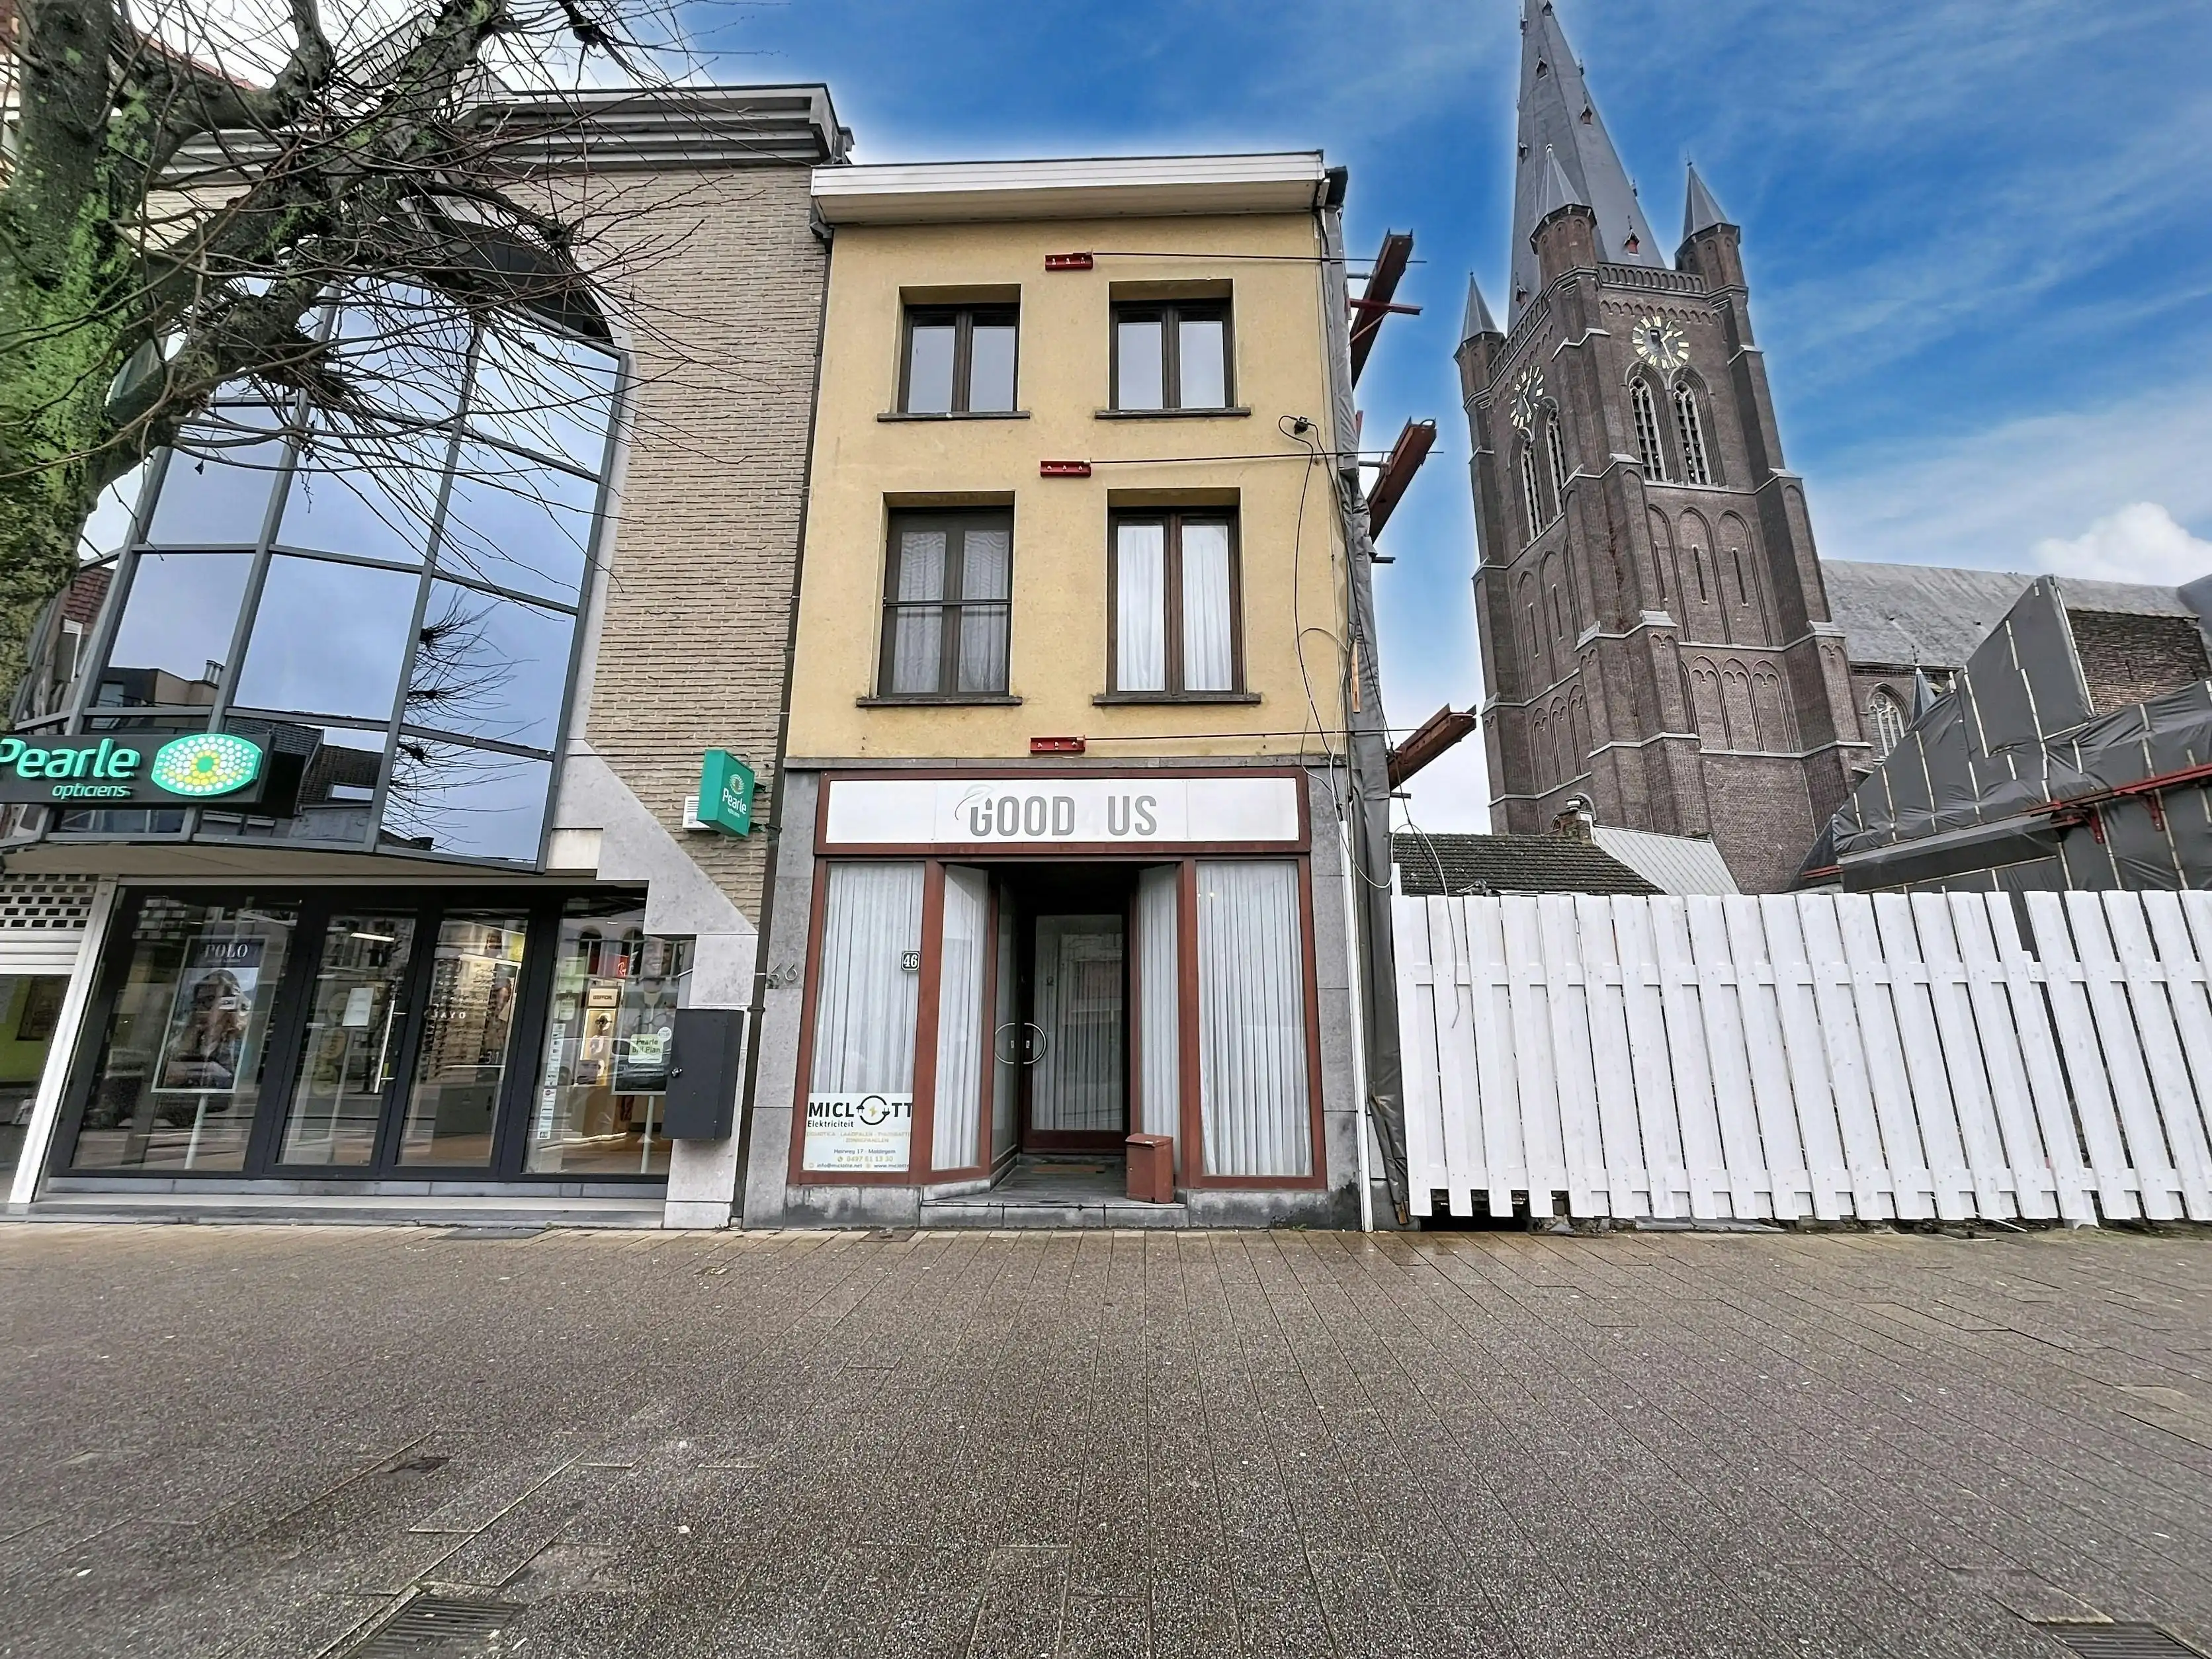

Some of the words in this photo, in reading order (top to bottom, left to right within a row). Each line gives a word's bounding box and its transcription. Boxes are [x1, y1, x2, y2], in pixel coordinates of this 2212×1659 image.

[52, 783, 132, 800] opticiens
[722, 787, 747, 814] Pearle
[970, 796, 1076, 837] GOOD
[1107, 796, 1158, 836] US
[903, 955, 918, 967] 46
